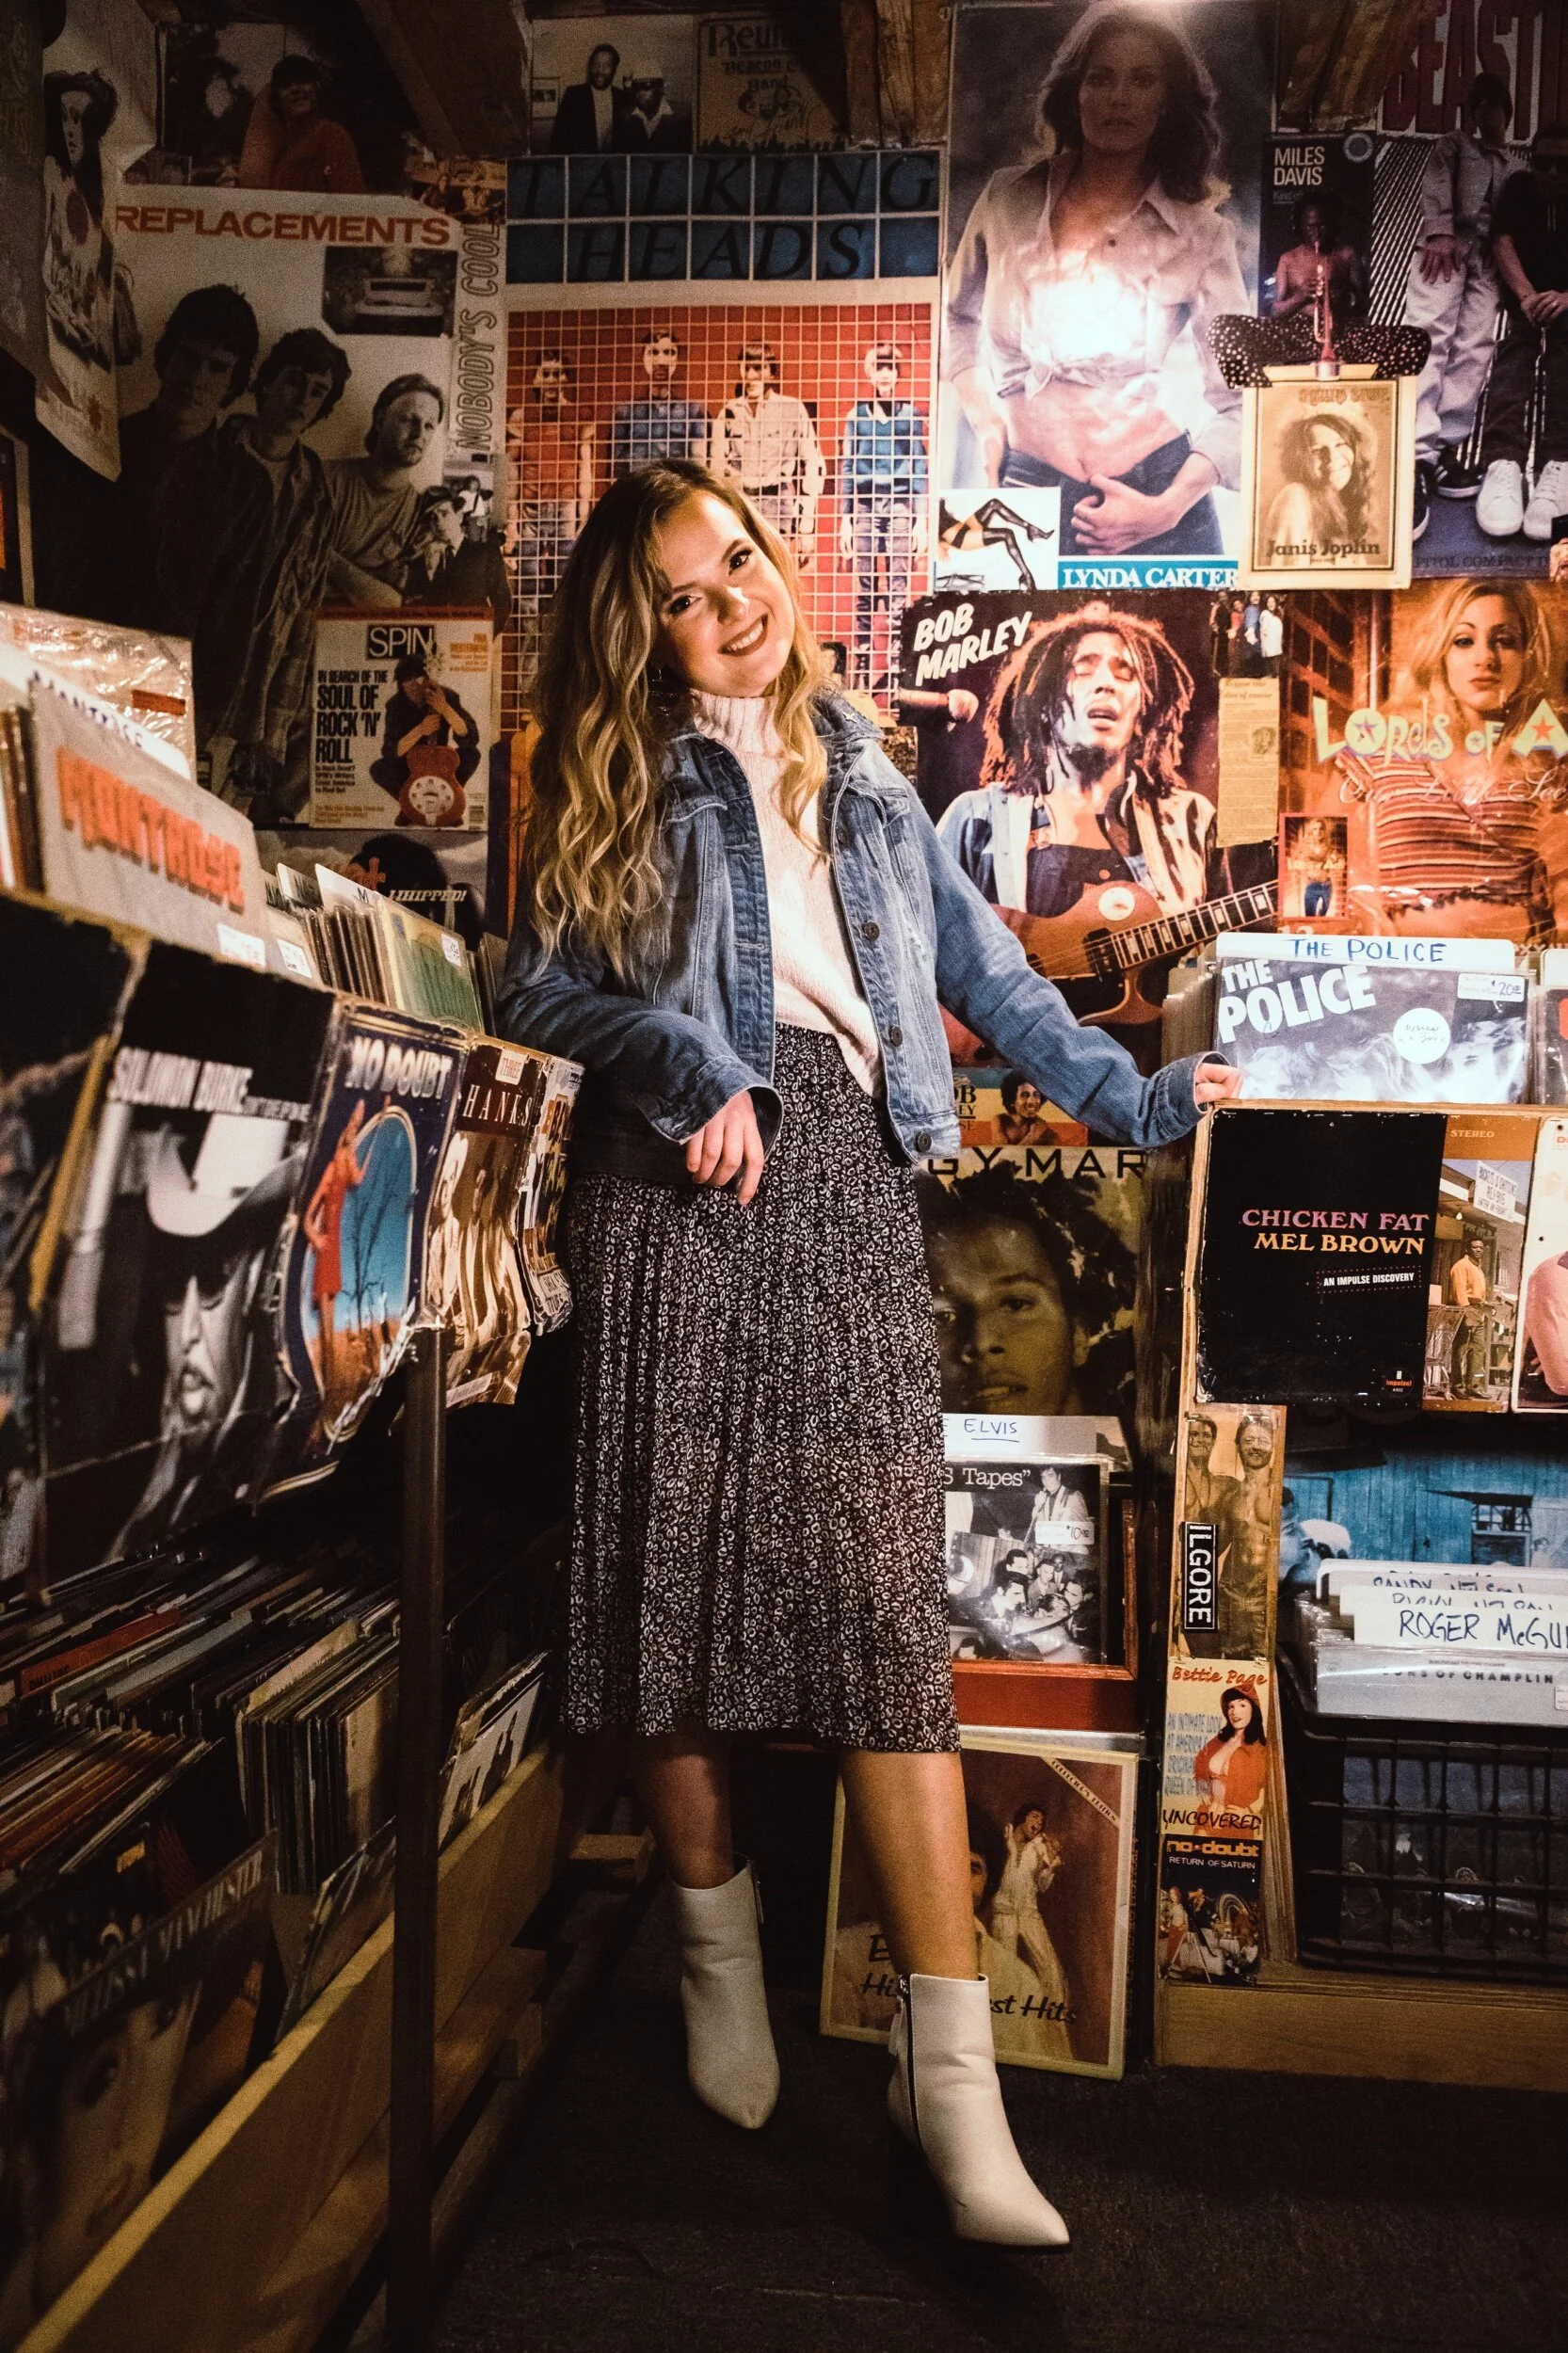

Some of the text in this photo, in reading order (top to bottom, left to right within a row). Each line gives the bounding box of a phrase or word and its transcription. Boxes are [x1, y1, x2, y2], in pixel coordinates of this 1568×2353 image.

[1274, 146, 1325, 166] MILES
[513, 153, 936, 216] TALKING
[1273, 167, 1323, 185] DAVIS
[115, 205, 450, 246] REPLACEMENTS
[577, 222, 864, 280] HEADS
[456, 224, 501, 450] NOBODY'S COOL
[1268, 538, 1381, 558] Janis Joplin
[1063, 567, 1240, 590] LYNDA CARTER
[913, 602, 975, 652] BOB
[369, 626, 434, 657] SPIN
[915, 611, 1033, 687] MARLEY
[328, 670, 360, 683] SEARCH
[373, 670, 388, 683] THE
[317, 685, 378, 709] SOUL OF
[316, 712, 358, 737] ROCK
[315, 739, 353, 763] ROLL
[1290, 938, 1448, 963] THE POLICE
[1223, 959, 1273, 993] THE
[1218, 965, 1377, 1044] POLICE
[344, 1035, 454, 1100] NO DOUBT
[462, 1083, 534, 1127] HANKS
[1450, 1129, 1496, 1138] STEREO
[1241, 1209, 1430, 1231] CHICKEN FAT
[1254, 1232, 1425, 1255] MEL BROWN
[1323, 1272, 1415, 1287] AN IMPULSE DISCOVERY
[964, 1418, 1018, 1435] ELVIS
[1189, 1525, 1212, 1624] ILGORE
[1399, 1609, 1480, 1642] ROGER
[1172, 1665, 1268, 1687] Bettie Page
[1463, 1670, 1553, 1684] CHAMPLIN
[1162, 1808, 1262, 1831] UNCOVERED
[1169, 1856, 1205, 1866] RETURN
[1221, 1860, 1256, 1869] SATURN
[1019, 1994, 1077, 2023] Hits
